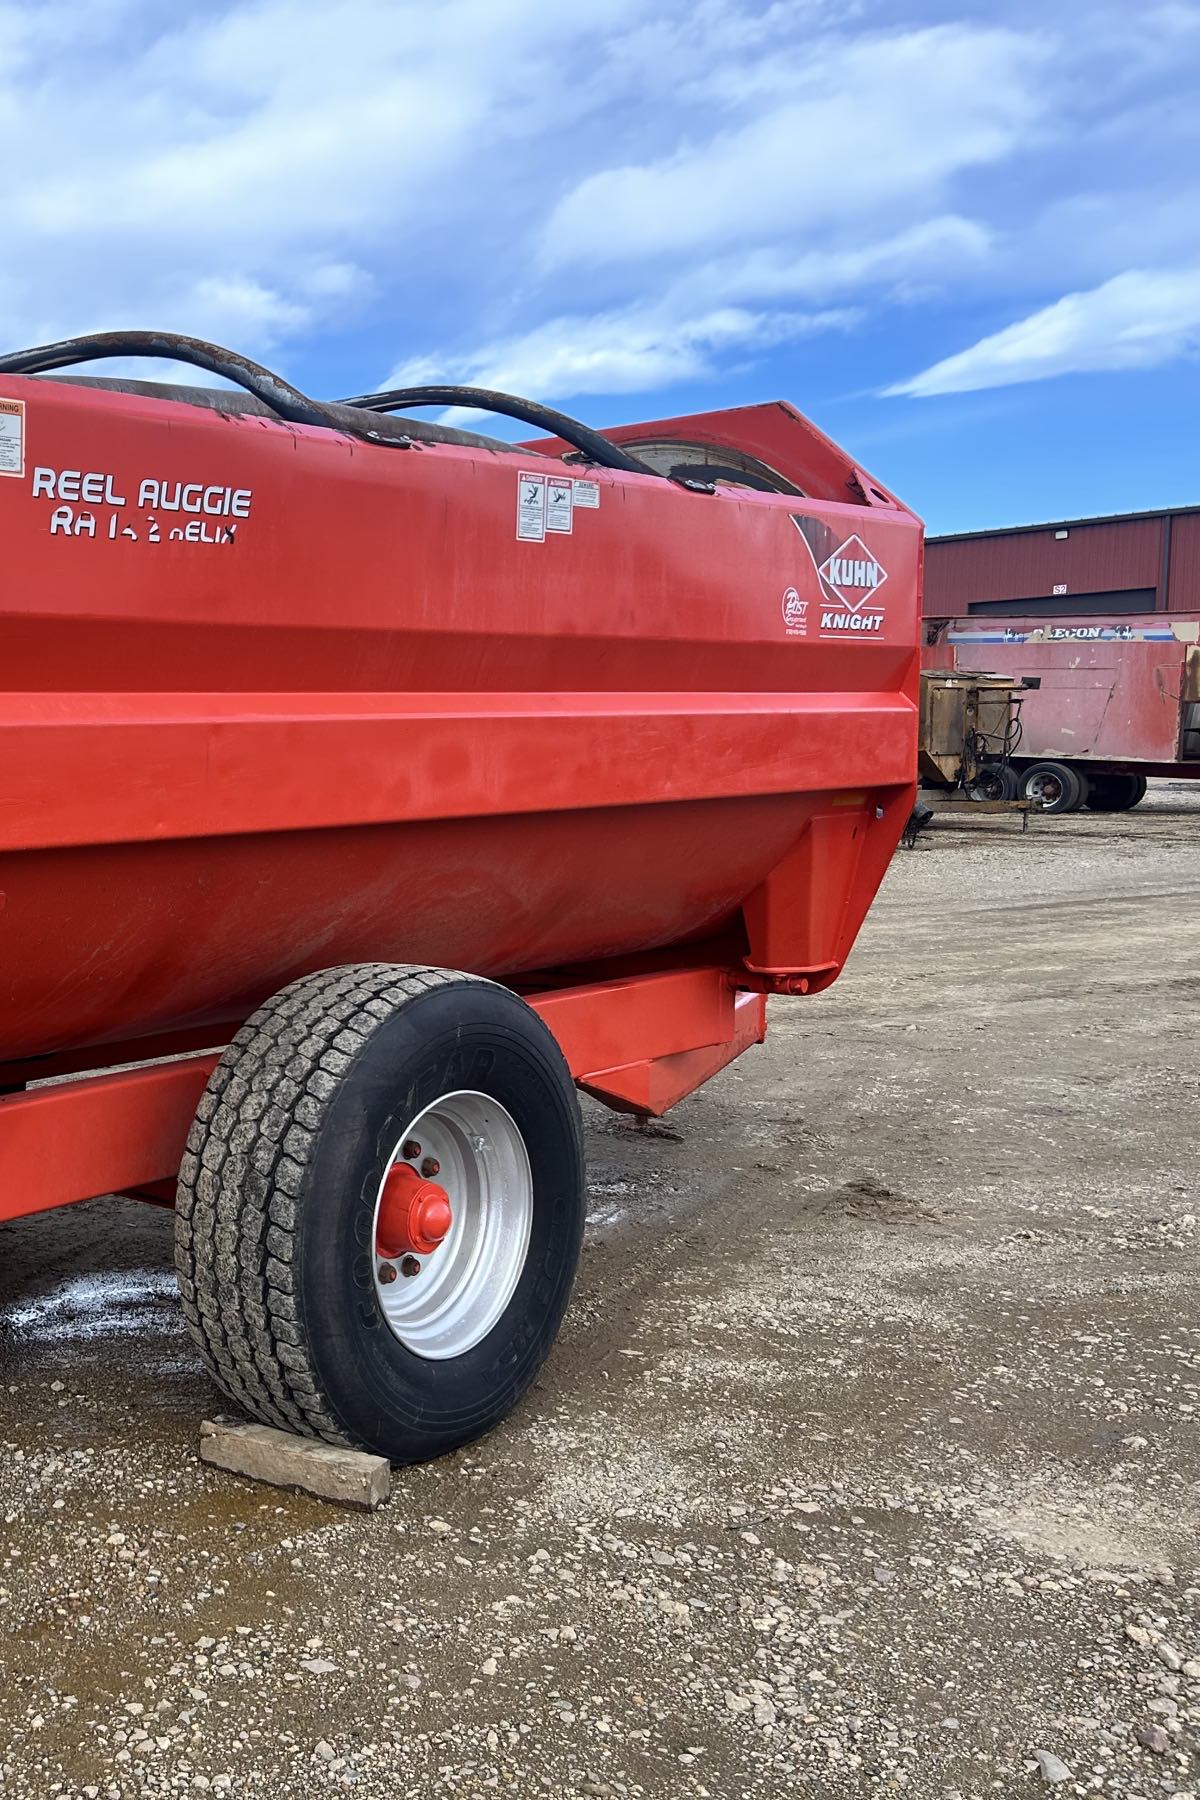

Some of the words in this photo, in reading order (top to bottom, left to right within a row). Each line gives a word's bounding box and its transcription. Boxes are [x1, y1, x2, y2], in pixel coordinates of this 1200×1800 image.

[32, 466, 126, 506] REEL
[138, 478, 252, 518] AUGGIE
[50, 505, 96, 537] RA
[829, 558, 878, 588] KUHN
[1054, 585, 1066, 594] S2
[820, 613, 884, 631] KNIGHT
